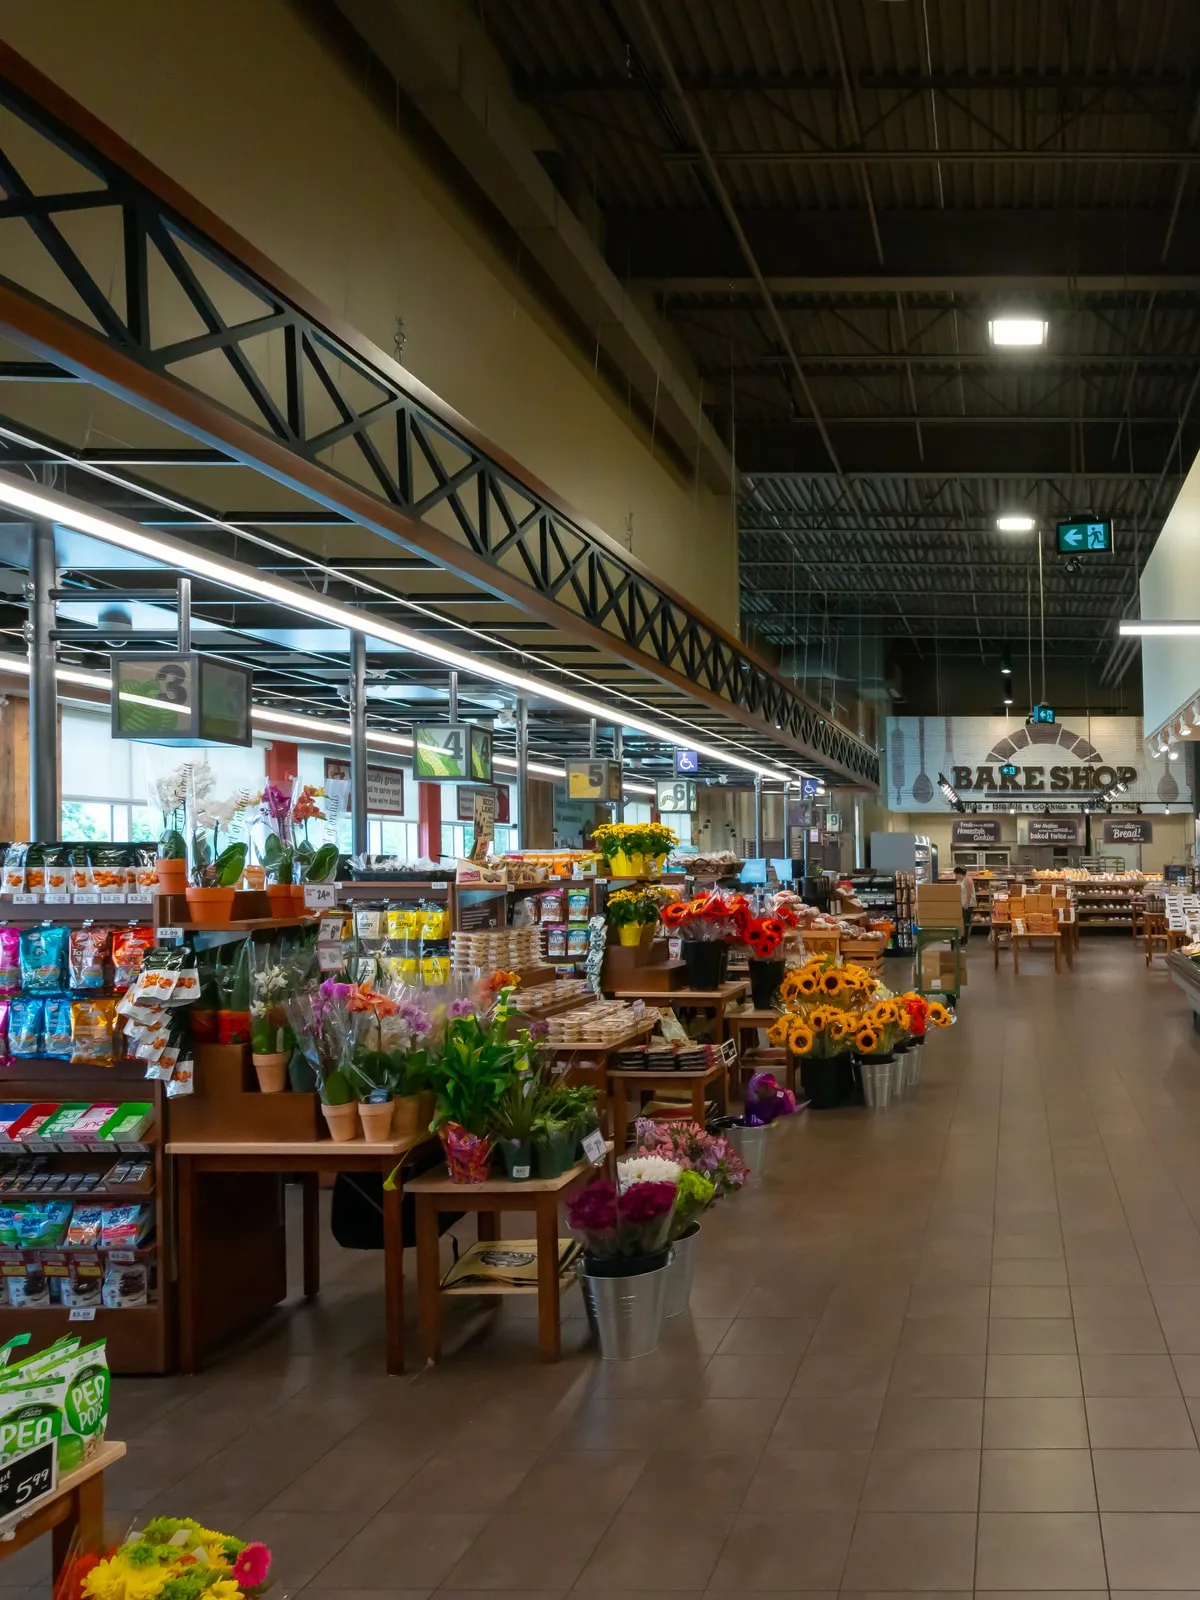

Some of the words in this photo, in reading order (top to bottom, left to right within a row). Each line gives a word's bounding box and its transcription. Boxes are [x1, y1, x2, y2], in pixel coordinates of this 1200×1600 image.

[155, 664, 187, 702] 3
[444, 730, 464, 760] 4
[588, 764, 603, 788] 5
[953, 766, 1045, 790] BAKE
[1050, 766, 1138, 790] SHOP
[672, 783, 685, 803] 6
[830, 815, 838, 826] 9
[1030, 832, 1049, 840] baked
[72, 1375, 106, 1413] PEA
[0, 1417, 53, 1449] PEA
